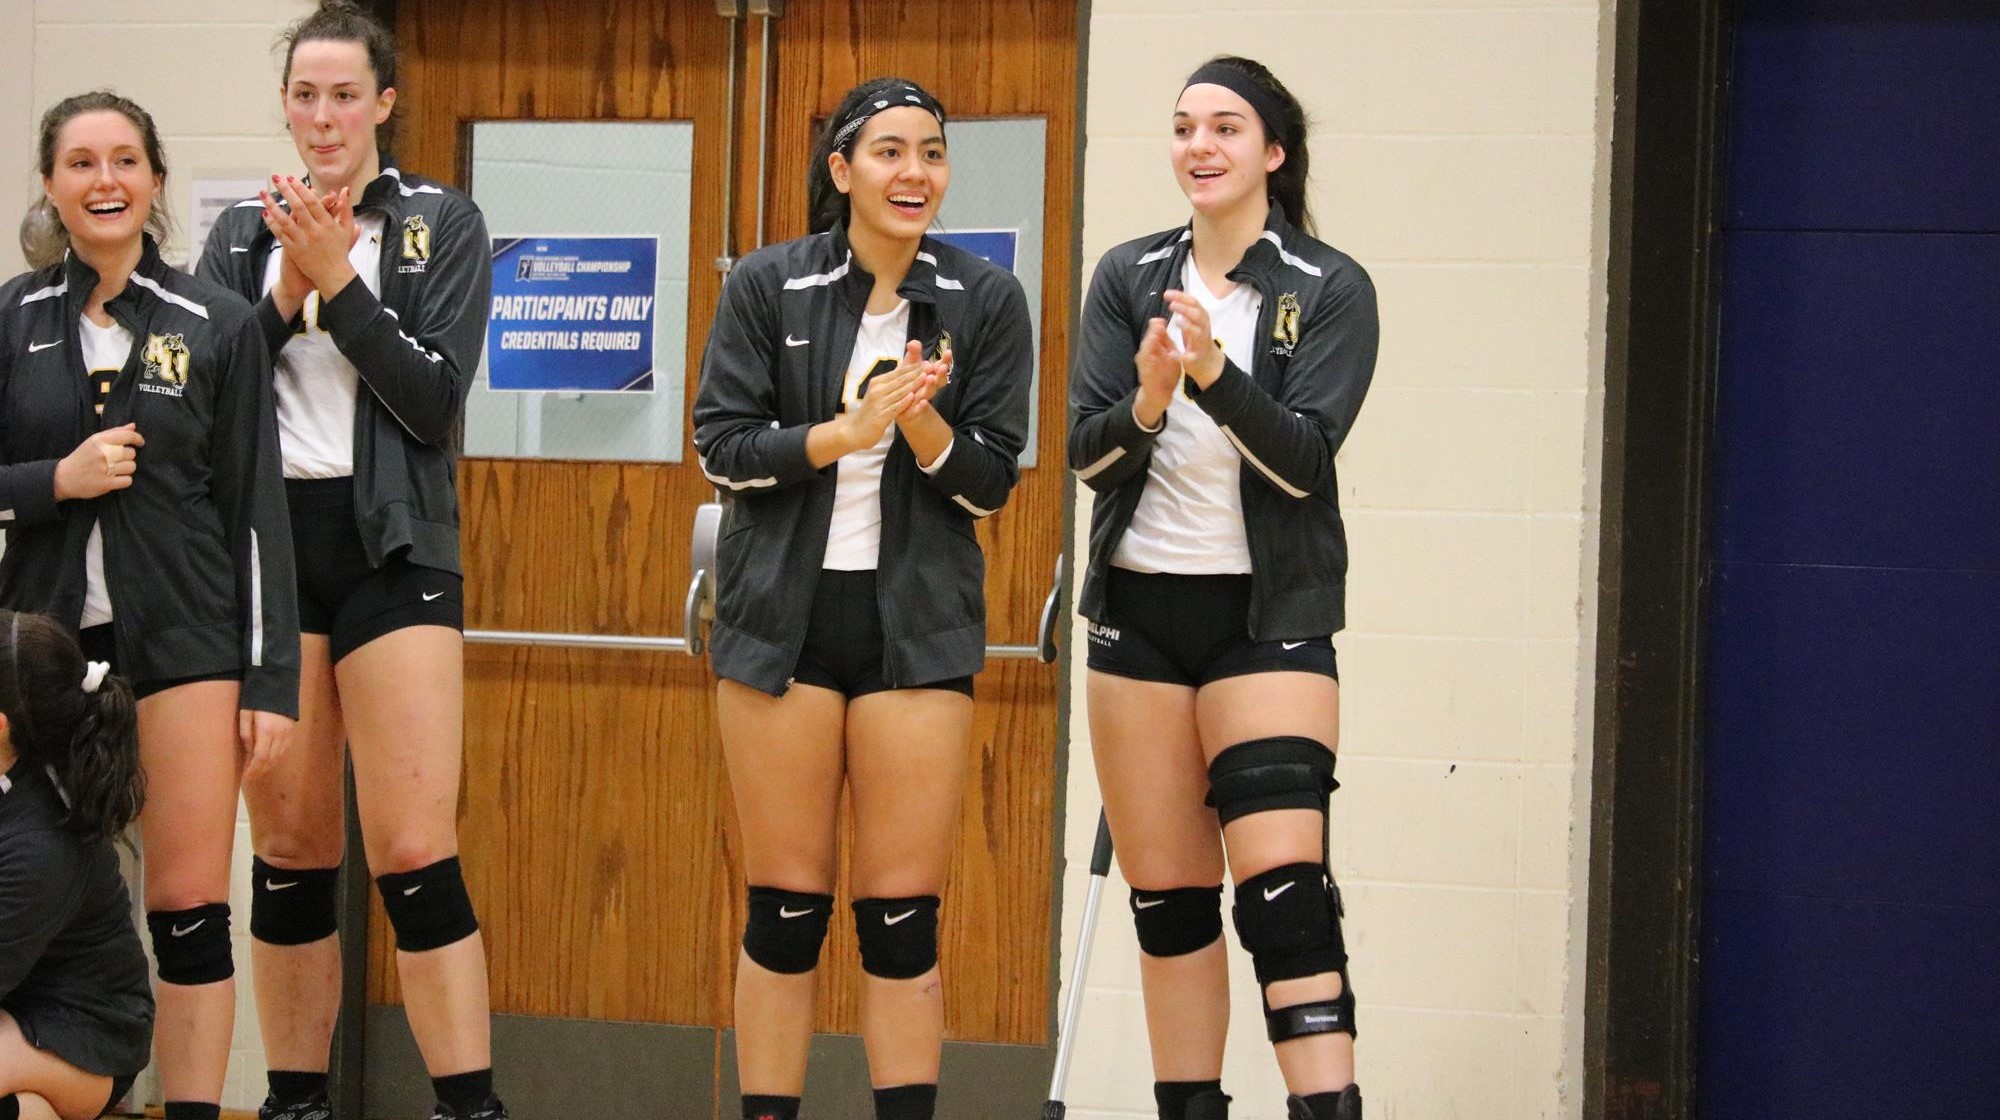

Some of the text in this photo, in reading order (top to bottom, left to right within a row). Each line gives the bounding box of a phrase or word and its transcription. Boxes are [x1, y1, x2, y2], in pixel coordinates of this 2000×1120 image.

[532, 261, 631, 273] VOLLEYBALL CHAMPIONSHIP
[491, 295, 653, 321] PARTICIPANTS ONLY
[501, 331, 641, 351] CREDENTIALS REQUIRED
[138, 383, 184, 397] VOLLEYBALL
